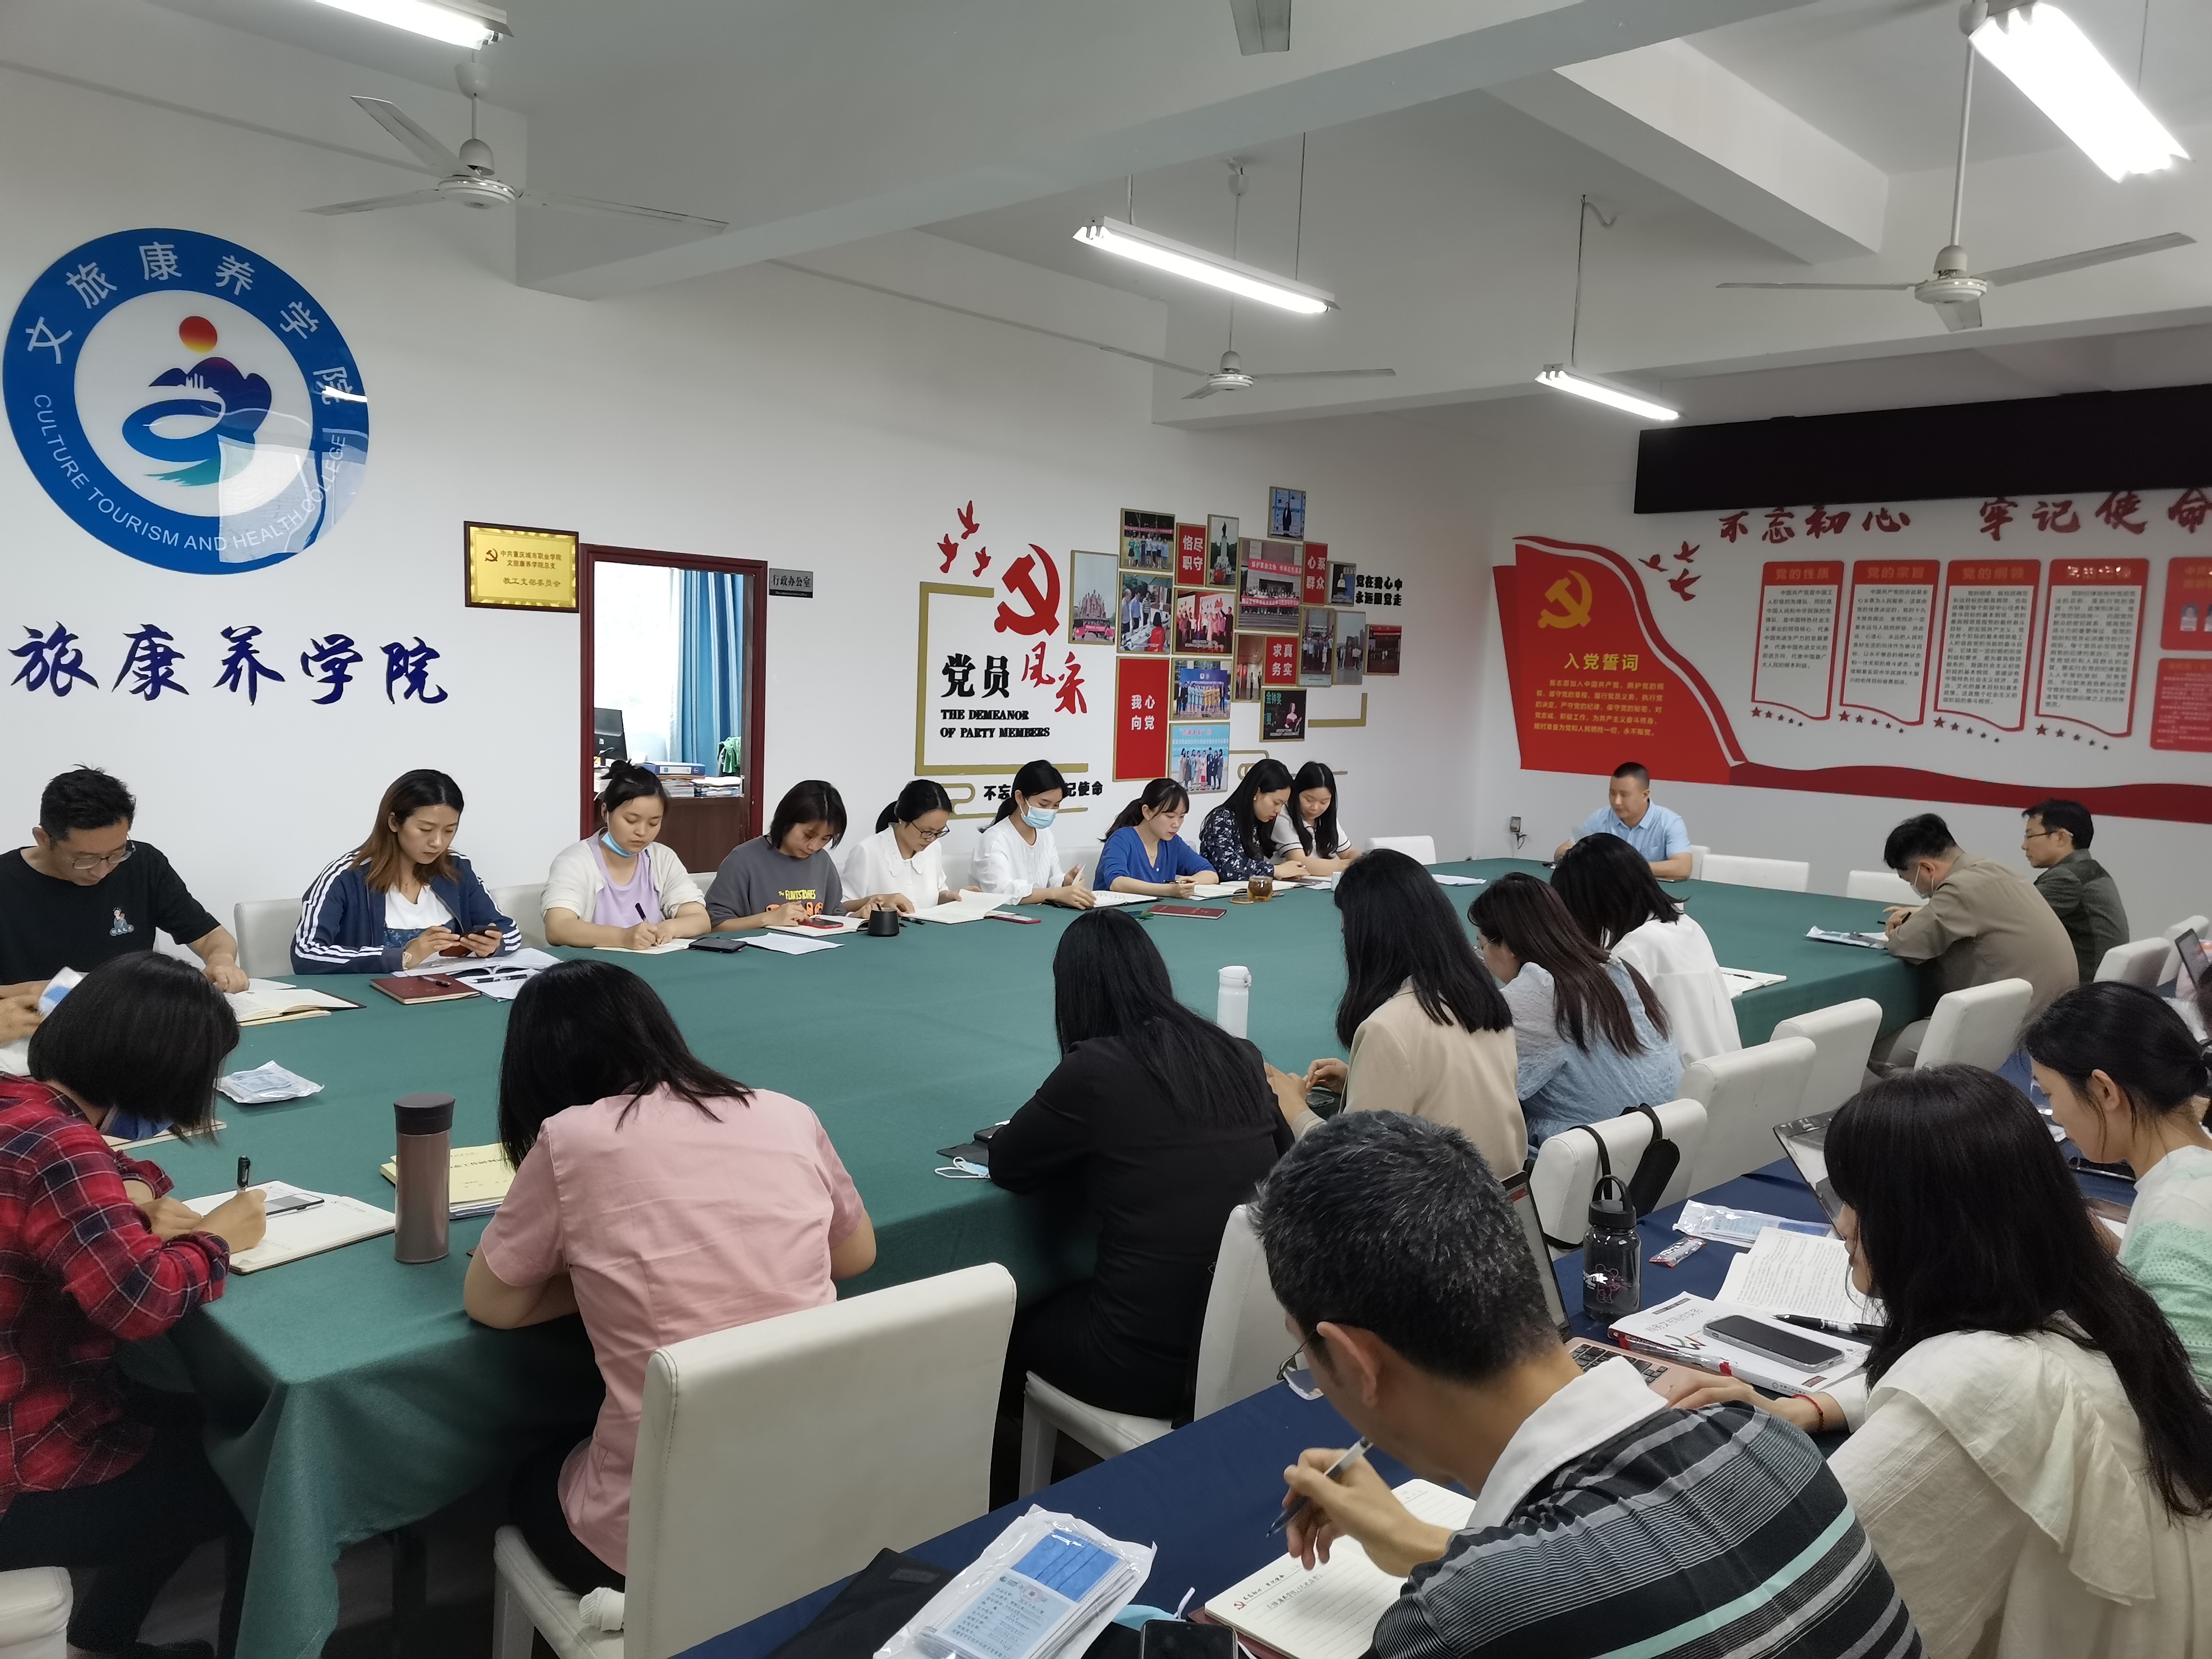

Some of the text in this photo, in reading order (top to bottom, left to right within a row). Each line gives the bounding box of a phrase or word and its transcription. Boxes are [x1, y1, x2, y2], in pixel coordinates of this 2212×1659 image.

[25, 241, 354, 405] 文旅康养学院
[33, 394, 346, 551] CULTURE TOURISM AND HEALTH COLLEGE
[1718, 488, 2212, 544] 不忘初心 牢记使命
[1182, 535, 1203, 552] 恪尽
[1182, 555, 1203, 571] 职守
[1307, 555, 1326, 570] 心系
[773, 575, 811, 587] 行政办公室
[1775, 567, 1829, 580] 党的性质
[1306, 576, 1326, 590] 群众
[1272, 643, 1293, 658] 求真
[8, 620, 448, 706] 旅康养学院
[1271, 662, 1292, 676] 务实
[1564, 653, 1639, 672] 入党誓词
[1131, 694, 1155, 709] 我心
[941, 709, 1029, 720] THE DEMEANOR
[1131, 715, 1155, 731] 向党
[940, 727, 1050, 738] OF PARTY MEMBERS
